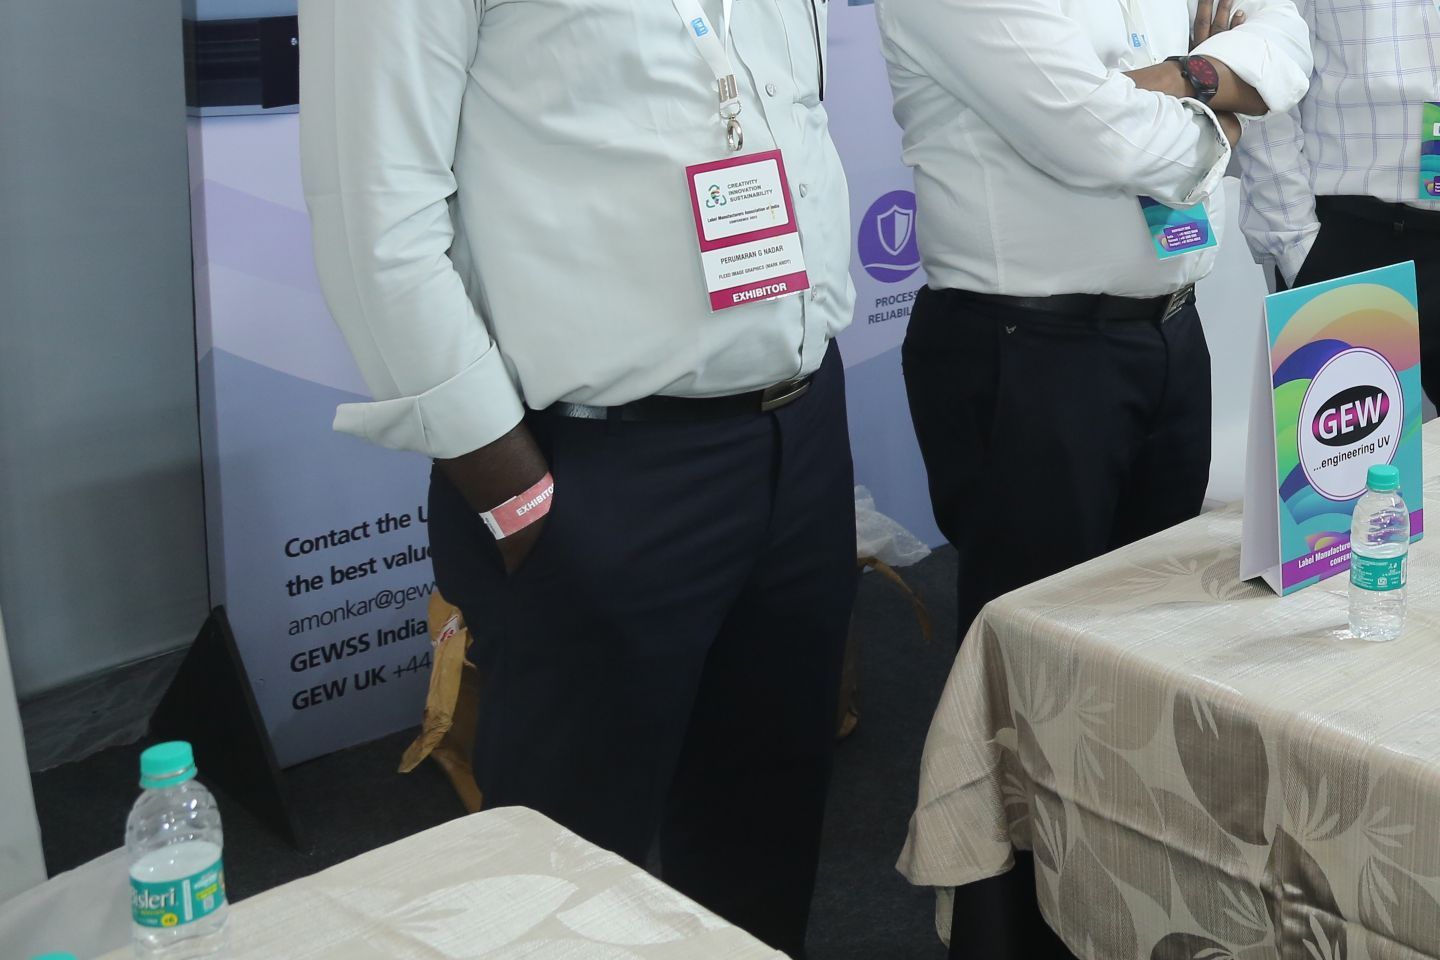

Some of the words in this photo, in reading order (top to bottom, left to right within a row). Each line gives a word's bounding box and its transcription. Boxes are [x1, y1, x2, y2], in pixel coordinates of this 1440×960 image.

[727, 179, 758, 189] CREATIVITY
[728, 185, 762, 196] INNOVATION
[729, 189, 773, 202] SUSTAINABILITY
[720, 250, 757, 264] PERUMARAN
[763, 245, 784, 255] NADAR
[732, 282, 787, 303] EXHIBITOR
[875, 291, 918, 308] PROCESS
[1318, 393, 1384, 440] GEW
[1313, 442, 1375, 472] ...engineering
[1377, 434, 1391, 450] UV
[516, 483, 554, 517] EXHIBITO
[284, 521, 370, 559] Contact
[376, 512, 411, 535] the
[285, 572, 324, 597] the
[330, 557, 377, 586] best
[1298, 556, 1314, 569] Label
[288, 580, 438, 637] amonkar@gew
[290, 633, 371, 673] GEWSS
[376, 619, 428, 648] India
[292, 676, 348, 712] GEW
[353, 665, 387, 691] UK
